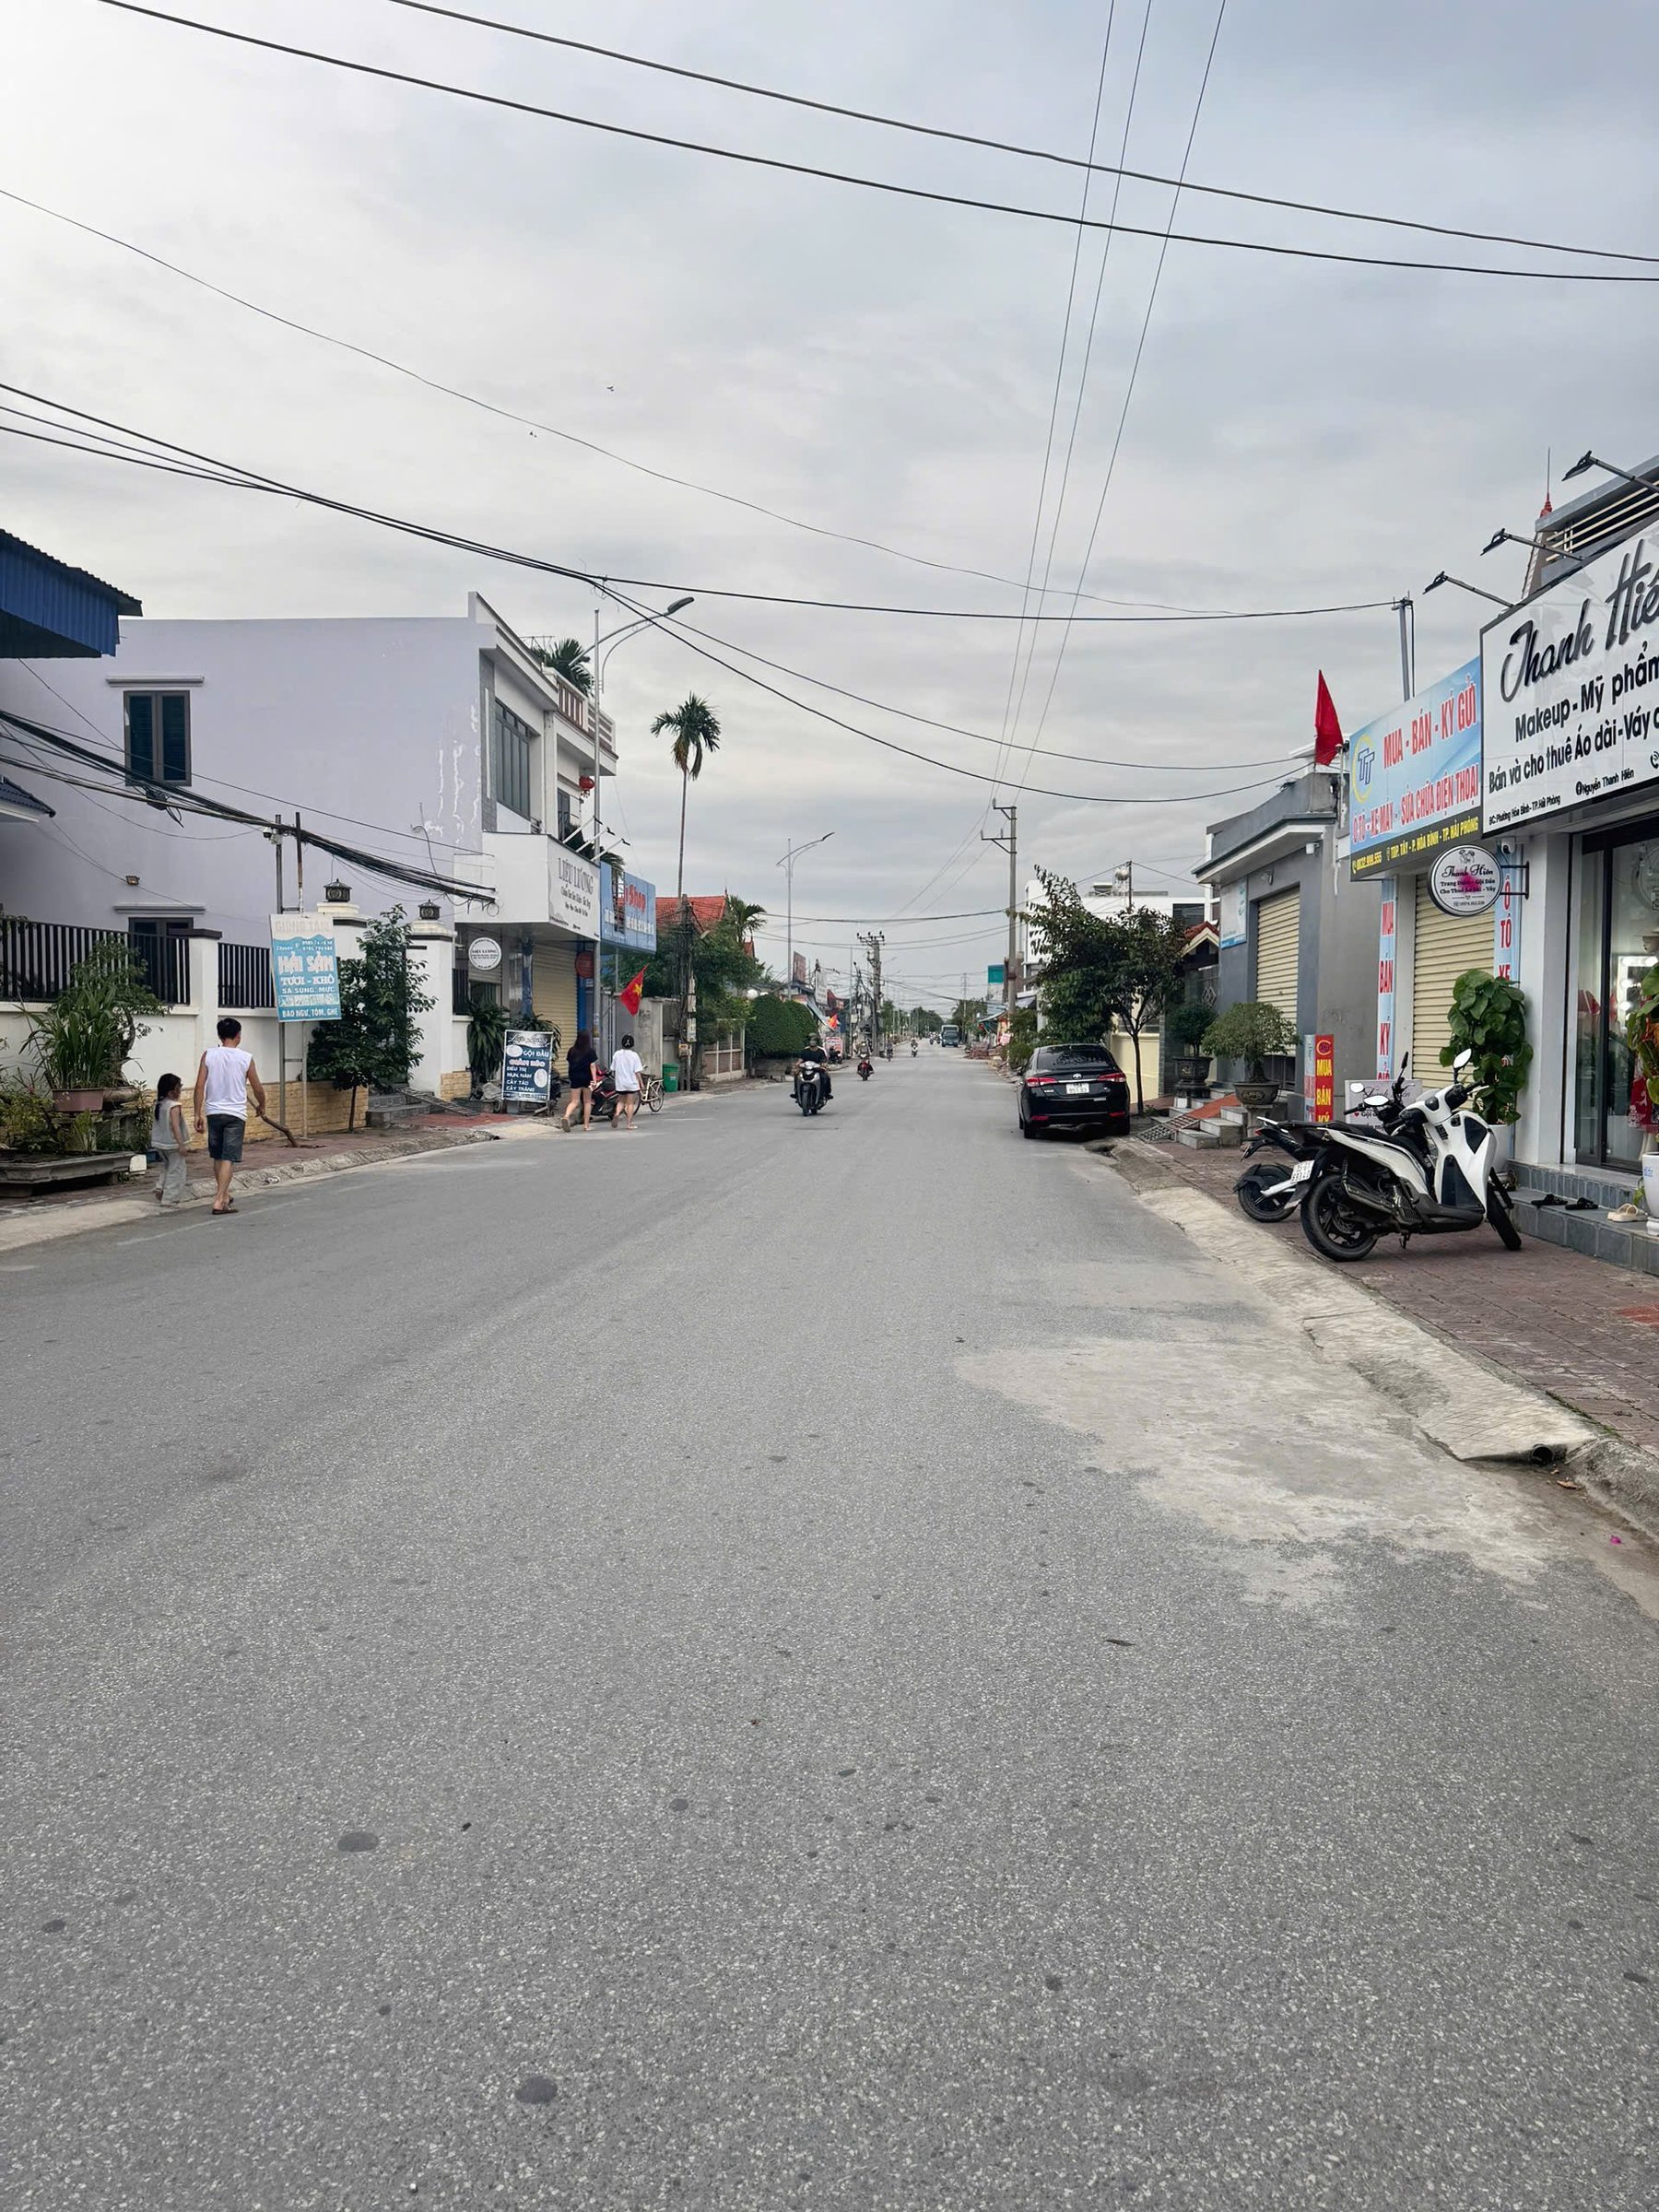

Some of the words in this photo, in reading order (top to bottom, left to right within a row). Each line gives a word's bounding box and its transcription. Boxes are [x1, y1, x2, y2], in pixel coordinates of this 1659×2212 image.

[1500, 598, 1594, 702] Thanh
[1515, 699, 1571, 743] Makeup
[1581, 675, 1605, 713] Mỹ
[1383, 728, 1404, 769] MUA
[1411, 708, 1431, 755] BÁN
[1441, 689, 1454, 739] KÝ
[1489, 766, 1506, 794] Bán
[1510, 759, 1521, 785] và
[1524, 754, 1544, 779] cho
[1547, 736, 1572, 771] thuê
[1574, 724, 1592, 760] Áo
[1436, 771, 1453, 816] ĐIỆN
[1455, 764, 1478, 805] THOẠI
[1441, 865, 1468, 877] Thanh
[1503, 875, 1512, 910] Ô
[1382, 901, 1394, 935] MUA
[1500, 913, 1512, 948] TÔ
[313, 973, 335, 985] KHÔ
[1379, 952, 1394, 994] BÁN
[1316, 1059, 1332, 1077] MUA
[1316, 1085, 1331, 1105] BÁN
